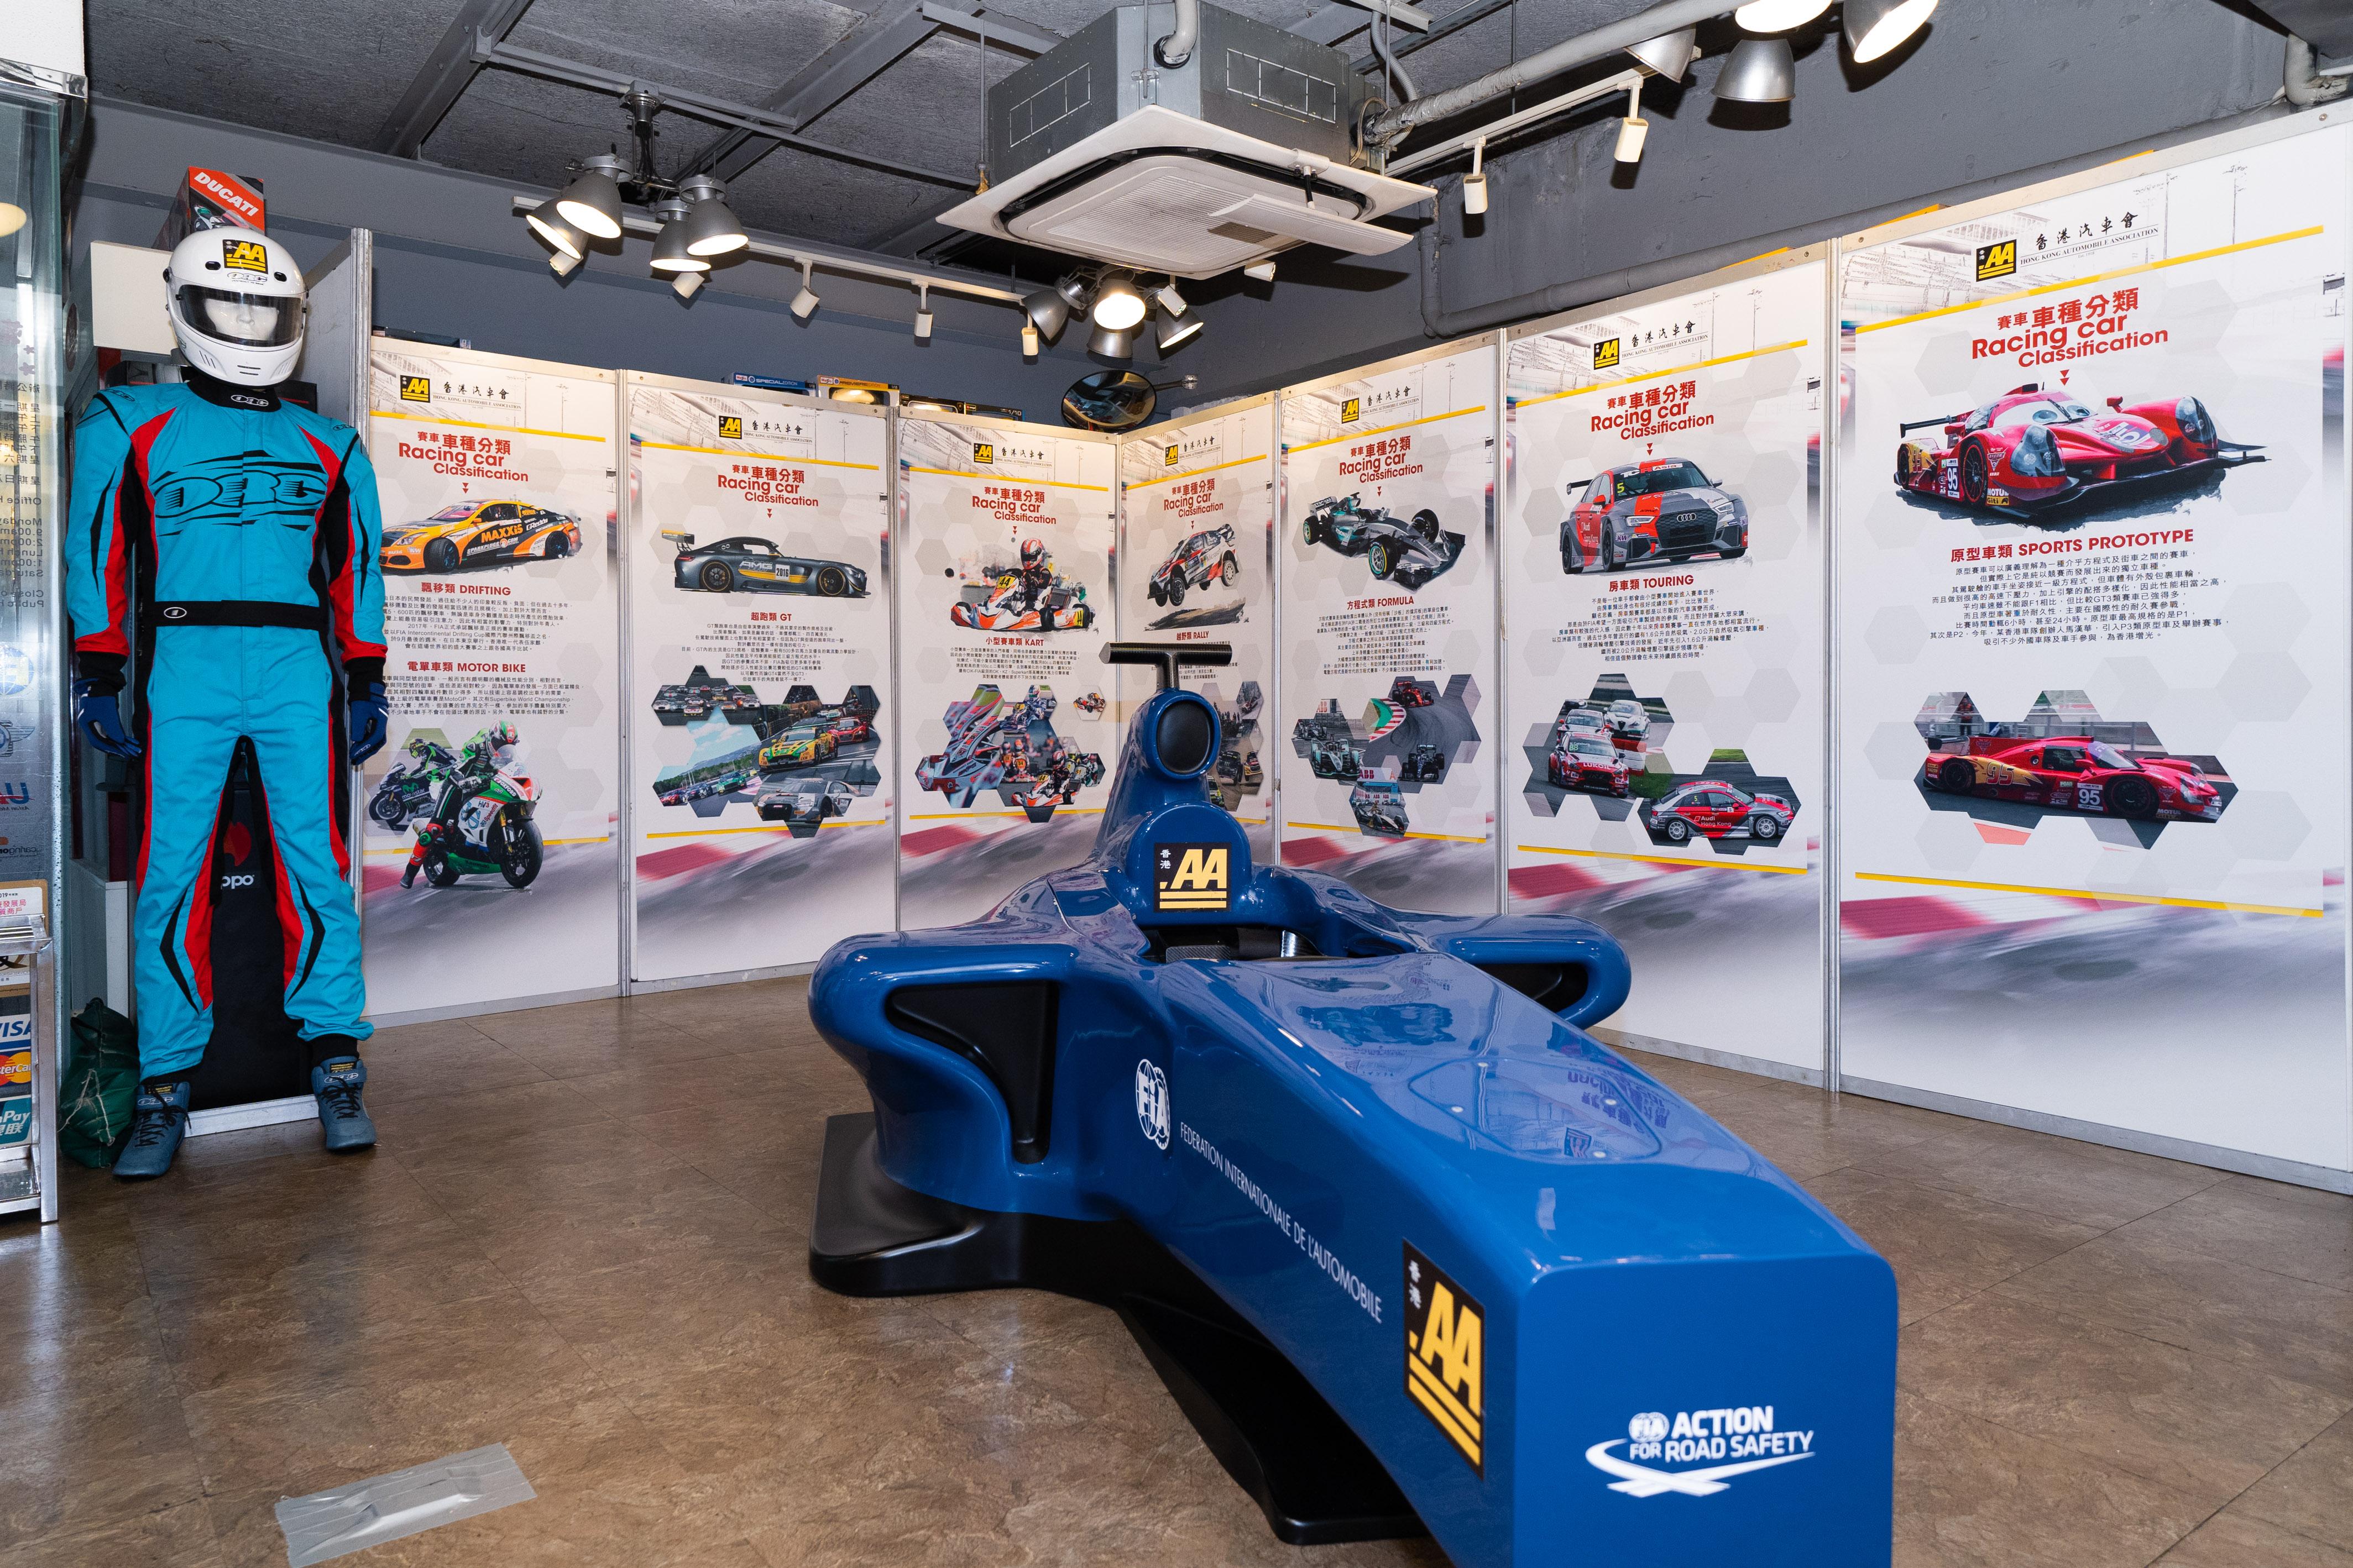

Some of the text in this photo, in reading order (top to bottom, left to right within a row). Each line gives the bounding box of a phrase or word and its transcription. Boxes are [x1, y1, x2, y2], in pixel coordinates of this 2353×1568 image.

[194, 172, 259, 217] DUCATI
[2036, 211, 2138, 250] 香港汽車會
[2042, 251, 2061, 260] KONG
[2063, 240, 2109, 254] AUTOMOBILE
[2111, 228, 2158, 244] ASSOCIATION
[2032, 287, 2139, 329] 車種分類
[1632, 320, 1696, 347] 香港汽車會
[1973, 315, 2127, 359] Racing car
[1649, 342, 1678, 352] AUTOMOBILE
[1679, 335, 1708, 346] ASSOCIATION
[2019, 330, 2168, 368] Classification
[443, 381, 509, 400] 香港汽車會
[1367, 386, 1411, 406] 香港汽車會
[1629, 380, 1696, 410] 車種分類
[1591, 402, 1689, 432] Racing car
[752, 420, 802, 435] 香港汽車會
[1620, 415, 1714, 440] Classification
[442, 434, 511, 455] 車種分類
[1001, 447, 1044, 460] 香港汽車會
[1366, 436, 1410, 458] 車種分類
[399, 443, 504, 467] Racing car
[1340, 453, 1406, 475] Racing car
[433, 463, 529, 482] Classification
[752, 466, 804, 484] 車種分類
[1359, 465, 1423, 484] Classification
[1947, 468, 1958, 490] 95
[718, 475, 799, 495] Racing car
[1183, 478, 1215, 495] 車種分類
[1617, 483, 1625, 494] 5
[745, 493, 819, 506] Classification
[972, 496, 1040, 513] Racing car
[1001, 488, 1044, 504] 車種分類
[1164, 491, 1211, 511] Racing car
[995, 511, 1056, 525] Classification
[1178, 502, 1223, 518] Classification
[1951, 529, 2194, 562] 原型車類 SPORTS PROTOTYPE
[776, 568, 789, 577] 2016
[999, 577, 1010, 586] 44
[460, 584, 511, 595] DRIFTING
[1609, 575, 1694, 592] 房車類 TOURING
[1347, 596, 1414, 610] 方程式類 FORMULA
[751, 612, 792, 621] 超跑類 GT
[986, 637, 1022, 646] 小型賽車類
[1194, 631, 1209, 639] RALLY
[408, 661, 526, 673] 電單車類 MOTOR BIKE
[1358, 769, 1374, 779] ABB
[1986, 762, 2015, 785] 95
[499, 782, 517, 797] OXFORD
[2079, 789, 2100, 805] 95
[1160, 849, 1171, 869] 香港
[221, 875, 254, 890] ppo
[1180, 1121, 1382, 1324] FEDERATION INTERNATIONALE DE L'AUTOMOBILE
[1671, 1406, 1774, 1439] ACTION
[1629, 1430, 1814, 1463] FOR ROAD SAFETY
